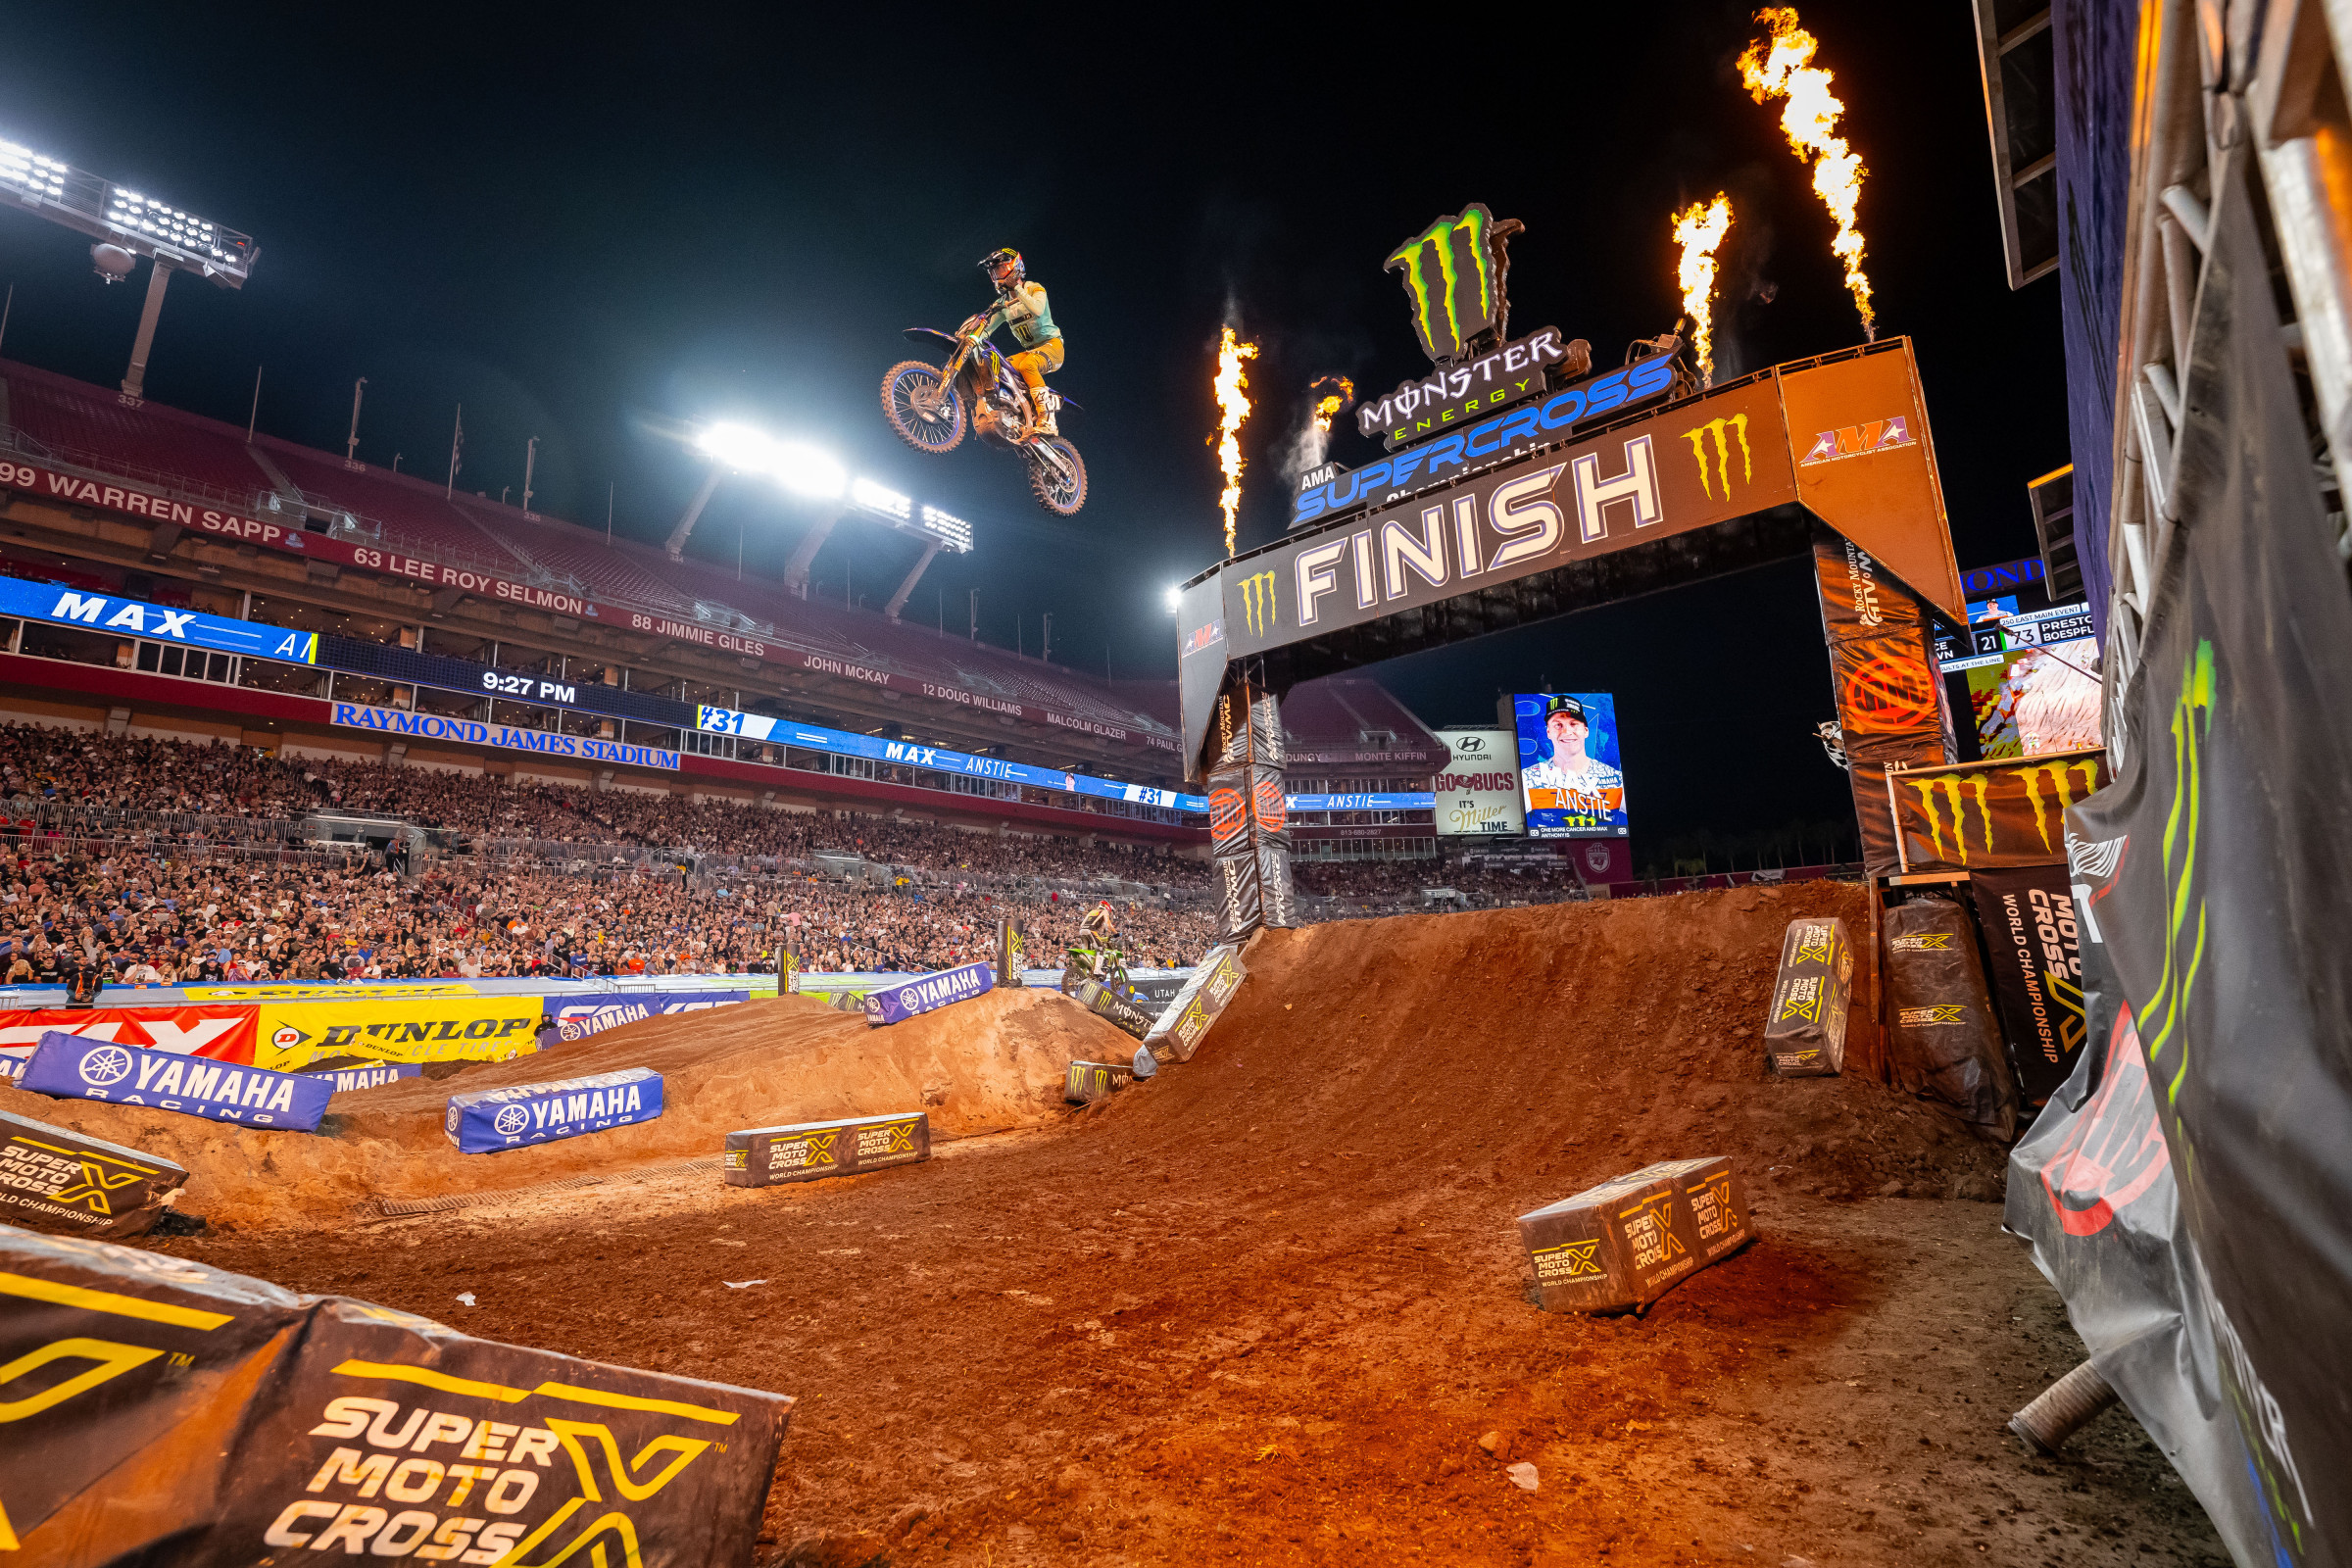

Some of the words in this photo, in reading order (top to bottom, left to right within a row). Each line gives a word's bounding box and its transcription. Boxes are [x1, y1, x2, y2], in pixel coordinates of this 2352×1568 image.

[1362, 331, 1563, 430] MONSTER
[118, 394, 145, 409] 337
[1394, 377, 1530, 441] ENERGY
[1294, 352, 1674, 524] SUPERCROSS
[1798, 416, 1917, 464] AMA
[344, 460, 367, 473] 336
[1800, 459, 1831, 467] AMERICAN
[1832, 450, 1876, 461] MOTORCYCLIST
[1877, 441, 1917, 453] ASSOCIATION
[1301, 466, 1336, 490] AMA
[0, 463, 36, 487] 99
[48, 472, 193, 525] WARREN
[201, 511, 281, 543] SAPP
[1296, 433, 1663, 627] FINISH
[1845, 538, 1859, 580] MOUNTA
[354, 547, 381, 567] 63
[389, 555, 435, 580] LEE
[442, 567, 490, 592] ROY
[495, 581, 583, 614] SELMON
[1854, 582, 1865, 612] ROCKY
[51, 592, 197, 638] MAX
[2002, 617, 2015, 626] 250
[2016, 614, 2034, 623] EAST
[2034, 611, 2053, 620] MAIN
[2055, 607, 2079, 616] EVENT
[631, 613, 652, 630] 88
[656, 620, 713, 645] JIMMIE
[718, 634, 764, 657] GILES
[1182, 618, 1224, 657] AMA
[1981, 636, 1996, 651] 21
[2015, 629, 2034, 645] 73
[804, 655, 842, 674] JOHN
[845, 664, 890, 685] MCKAY
[483, 671, 532, 696] 9:27
[539, 681, 575, 705] PM
[922, 683, 935, 696] 12
[937, 687, 970, 704] DOUG
[972, 695, 1022, 716] WILLIAMS
[702, 706, 745, 736] #31
[1047, 712, 1092, 733] MALCOLM
[1093, 724, 1127, 741] GLAZER
[333, 704, 488, 745] RAYMOND
[492, 728, 576, 756] JAMES
[581, 740, 680, 769] STADIUM
[1147, 736, 1155, 746] 74
[1156, 738, 1176, 753] PAUL
[886, 742, 938, 765] MAX
[965, 758, 1013, 779] ANSTIE
[1286, 753, 1322, 762] DUNGY
[1355, 752, 1391, 761] MONTE
[1395, 752, 1427, 760] KIFFIN
[1139, 786, 1162, 805] #31
[1436, 772, 1456, 792] GO
[1474, 772, 1514, 792] BUCS
[1327, 796, 1374, 808] ANSTIE
[1459, 800, 1475, 808] IT'S
[1555, 788, 1613, 822] ANSTIE
[1449, 805, 1507, 832] Miller
[1480, 821, 1508, 832] TIME
[1222, 860, 1232, 899] MOUNTAIN
[2028, 888, 2070, 980] CROSS
[917, 968, 981, 1004] YAMAHA
[1789, 978, 1801, 1002] CROSS
[1797, 978, 1809, 1001] MOTO
[1808, 977, 1818, 1002] SUPER
[2002, 894, 2028, 946] WORLD
[2018, 949, 2058, 1063] CHAMPIONSHIP
[911, 989, 980, 1016] RACING
[1155, 989, 1176, 998] UTAH
[579, 1003, 650, 1037] YAMAHA
[1113, 1001, 1156, 1031] MONSTE
[316, 1018, 531, 1047] DUNLOP
[366, 1044, 403, 1057] DUNLOP
[135, 1054, 295, 1113] YAMAHA
[85, 1087, 273, 1124] RACING
[531, 1085, 641, 1129] YAMAHA
[506, 1115, 633, 1145] RACING
[858, 1130, 891, 1141] SUPER
[859, 1137, 890, 1148] MOTO
[0, 1145, 83, 1174] SUPER
[769, 1141, 808, 1153] SUPER
[772, 1149, 807, 1161] MOTO
[858, 1145, 890, 1156] CROSS
[878, 1152, 918, 1163] CHAMPIONSHIP
[0, 1158, 71, 1185] MOTO
[768, 1157, 808, 1170] CROSS
[769, 1171, 792, 1180] WORLD
[792, 1164, 839, 1177] CHAMPIONSHIP
[0, 1171, 65, 1196] ROSS
[19, 1198, 114, 1226] CHAMPIONSHIP
[1690, 1192, 1715, 1211] SUPER
[1697, 1205, 1718, 1225] MOTO
[1624, 1214, 1655, 1239] SUPER
[1632, 1230, 1658, 1250] MOTO
[1699, 1218, 1723, 1240] CROSS
[1534, 1251, 1569, 1263] SUPER
[1539, 1259, 1569, 1269] MOTO
[1635, 1245, 1663, 1270] CROSS
[1538, 1267, 1572, 1278] CROSS
[1542, 1279, 1561, 1288] WORLD
[1563, 1274, 1608, 1286] CHAMPIONSHIP
[308, 1396, 561, 1467] SUPER
[306, 1446, 540, 1516] MOTO
[264, 1500, 529, 1566] CROSS
